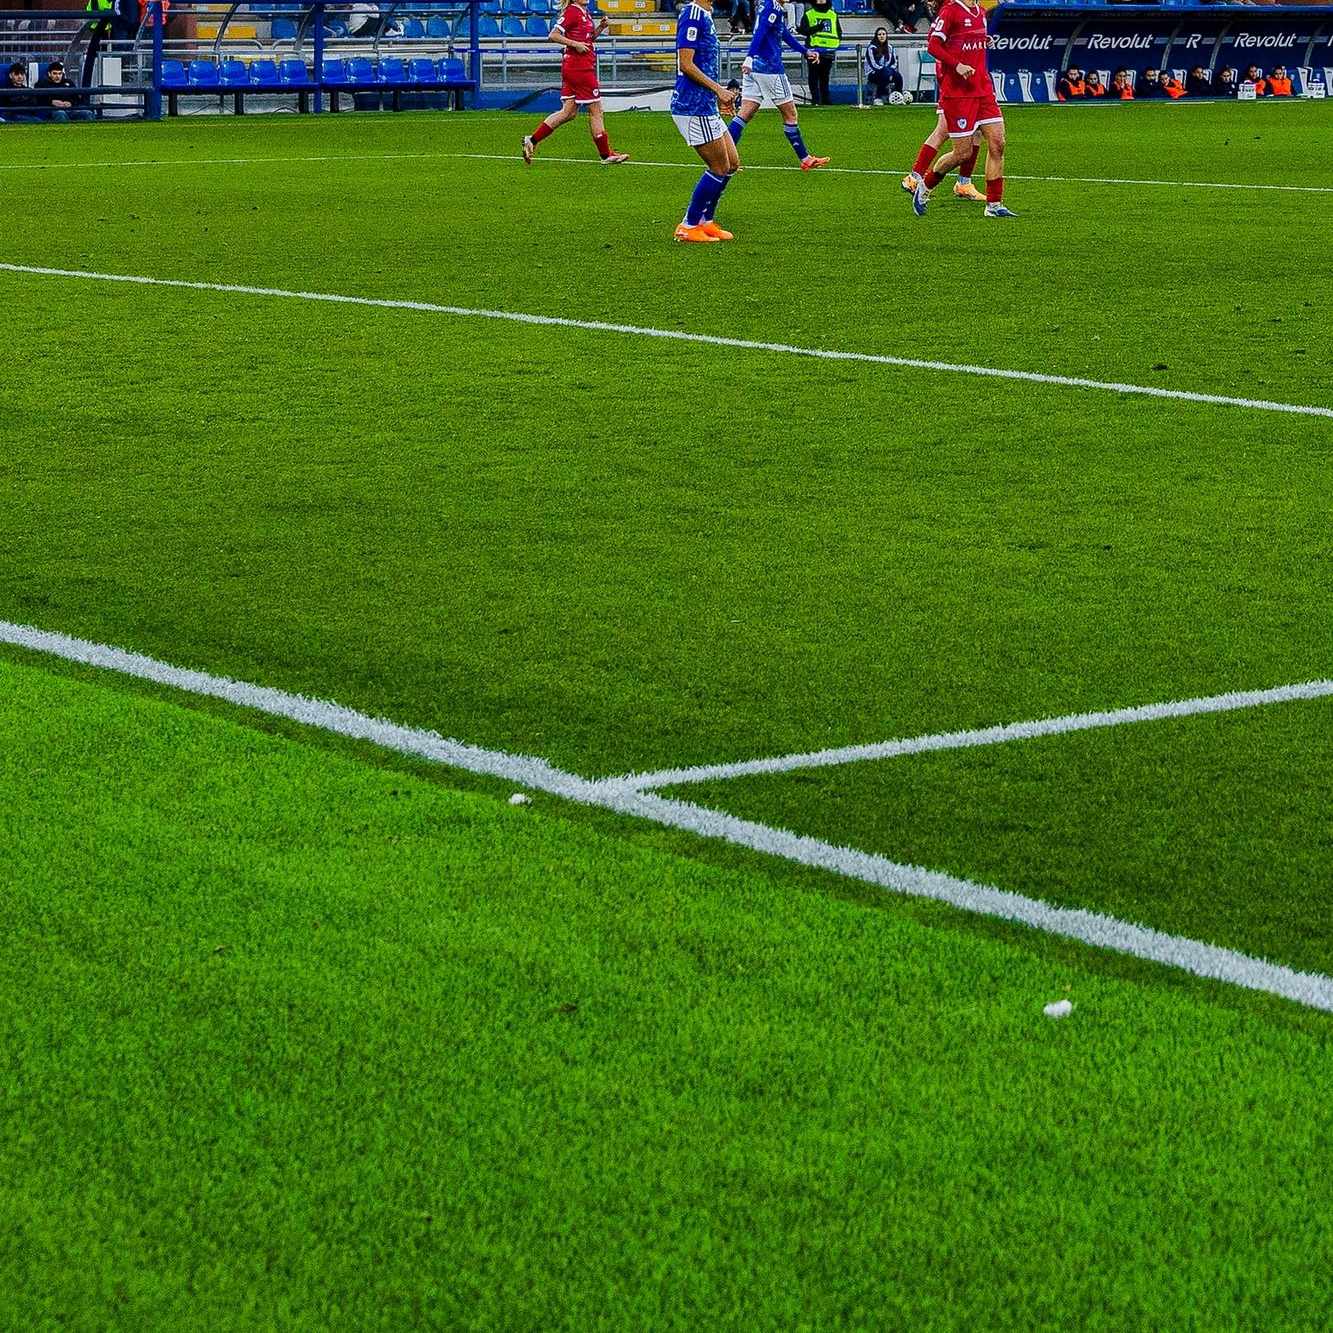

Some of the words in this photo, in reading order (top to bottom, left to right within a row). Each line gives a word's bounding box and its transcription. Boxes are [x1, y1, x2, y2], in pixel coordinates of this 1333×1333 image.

[1087, 34, 1154, 49] Revolut
[1186, 33, 1202, 49] R
[1234, 32, 1297, 48] Revolut
